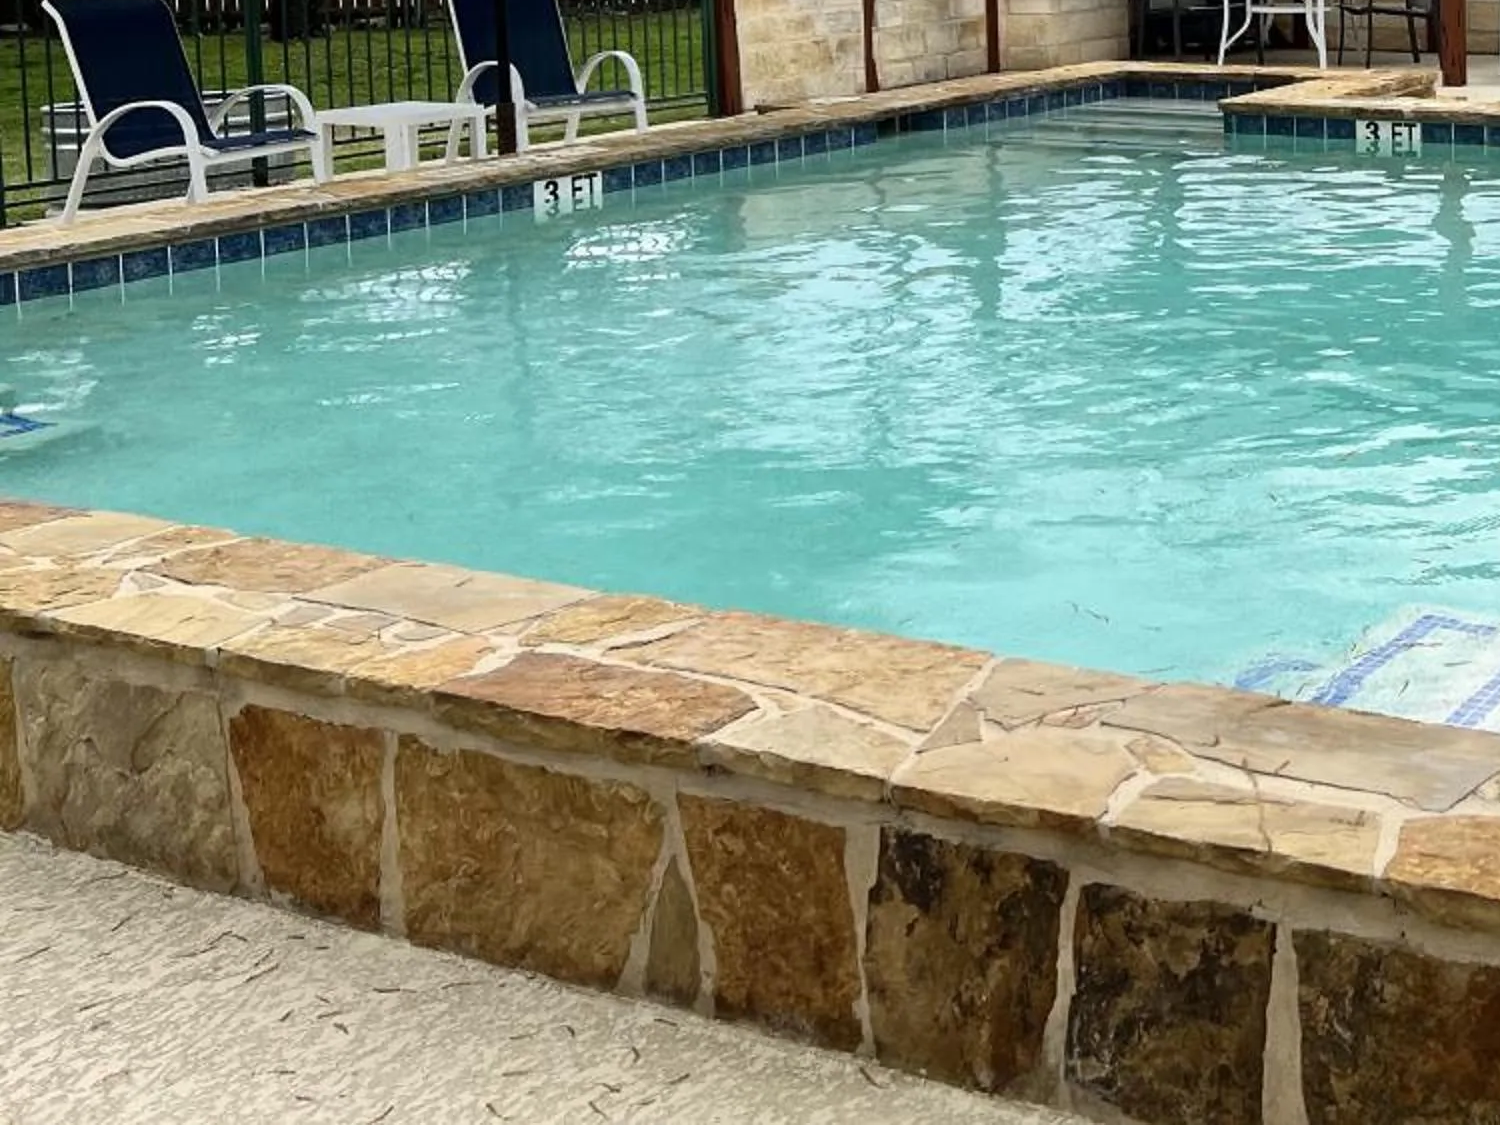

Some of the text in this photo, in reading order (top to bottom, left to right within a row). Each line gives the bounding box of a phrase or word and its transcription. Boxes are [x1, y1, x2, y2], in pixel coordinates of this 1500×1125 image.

[1366, 121, 1416, 141] 3 FT
[545, 173, 597, 203] 3 FT
